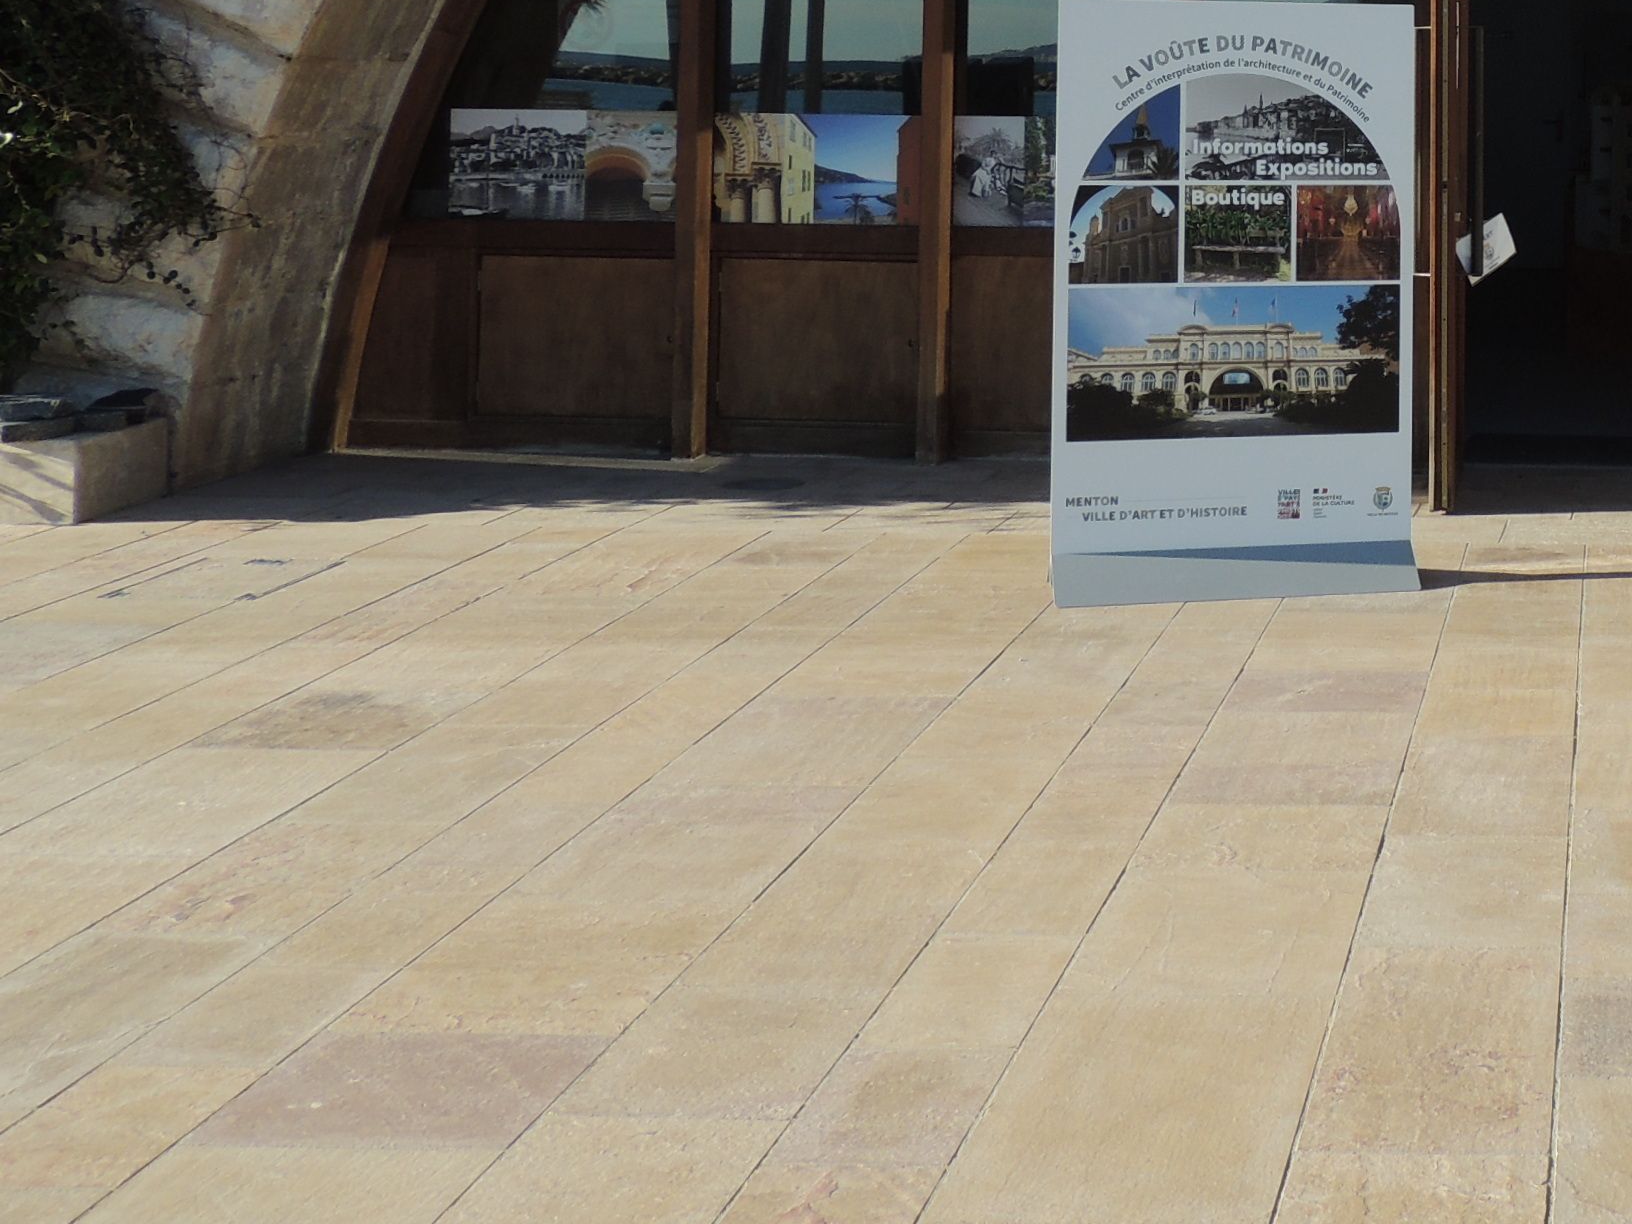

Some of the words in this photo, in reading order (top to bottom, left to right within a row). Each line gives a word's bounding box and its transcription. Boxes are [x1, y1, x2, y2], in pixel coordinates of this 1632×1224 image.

[1112, 65, 1142, 90] LA
[1139, 37, 1211, 72] VOÛTE
[1216, 34, 1245, 52] DU
[1251, 35, 1374, 101] PATRIMOINE
[1114, 87, 1145, 111] Centre
[1145, 59, 1221, 91] d'interprétation
[1223, 58, 1236, 67] de
[1238, 58, 1301, 78] l'architecture
[1302, 70, 1313, 82] et
[1313, 76, 1327, 91] du
[1327, 84, 1370, 123] Patrimoine
[1193, 138, 1329, 155] Informations
[1255, 158, 1378, 179] Expositions
[1191, 188, 1285, 210] Boutique
[1065, 496, 1119, 507] MENTON
[1082, 511, 1116, 522] VILLE
[1119, 509, 1157, 521] D'ART
[1159, 508, 1174, 519] ET
[1177, 506, 1248, 519] D'HISTOIRE
